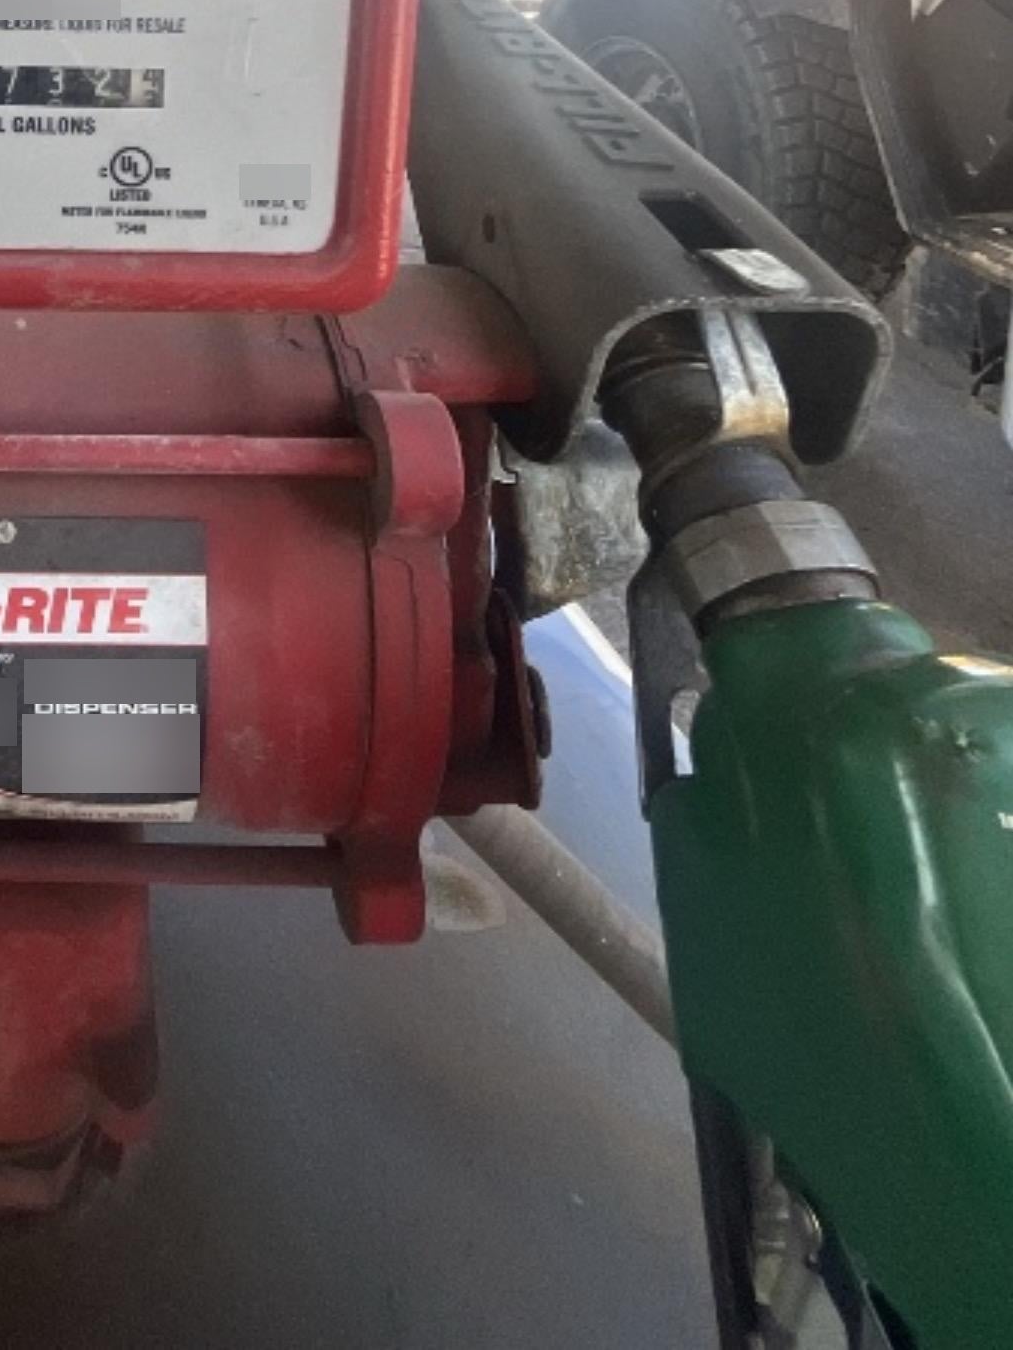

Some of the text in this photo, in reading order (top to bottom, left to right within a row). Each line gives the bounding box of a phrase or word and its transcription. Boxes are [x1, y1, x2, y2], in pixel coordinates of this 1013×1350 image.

[136, 17, 186, 34] RESALE
[13, 116, 97, 136] GALLONS
[110, 188, 151, 202] LISTED
